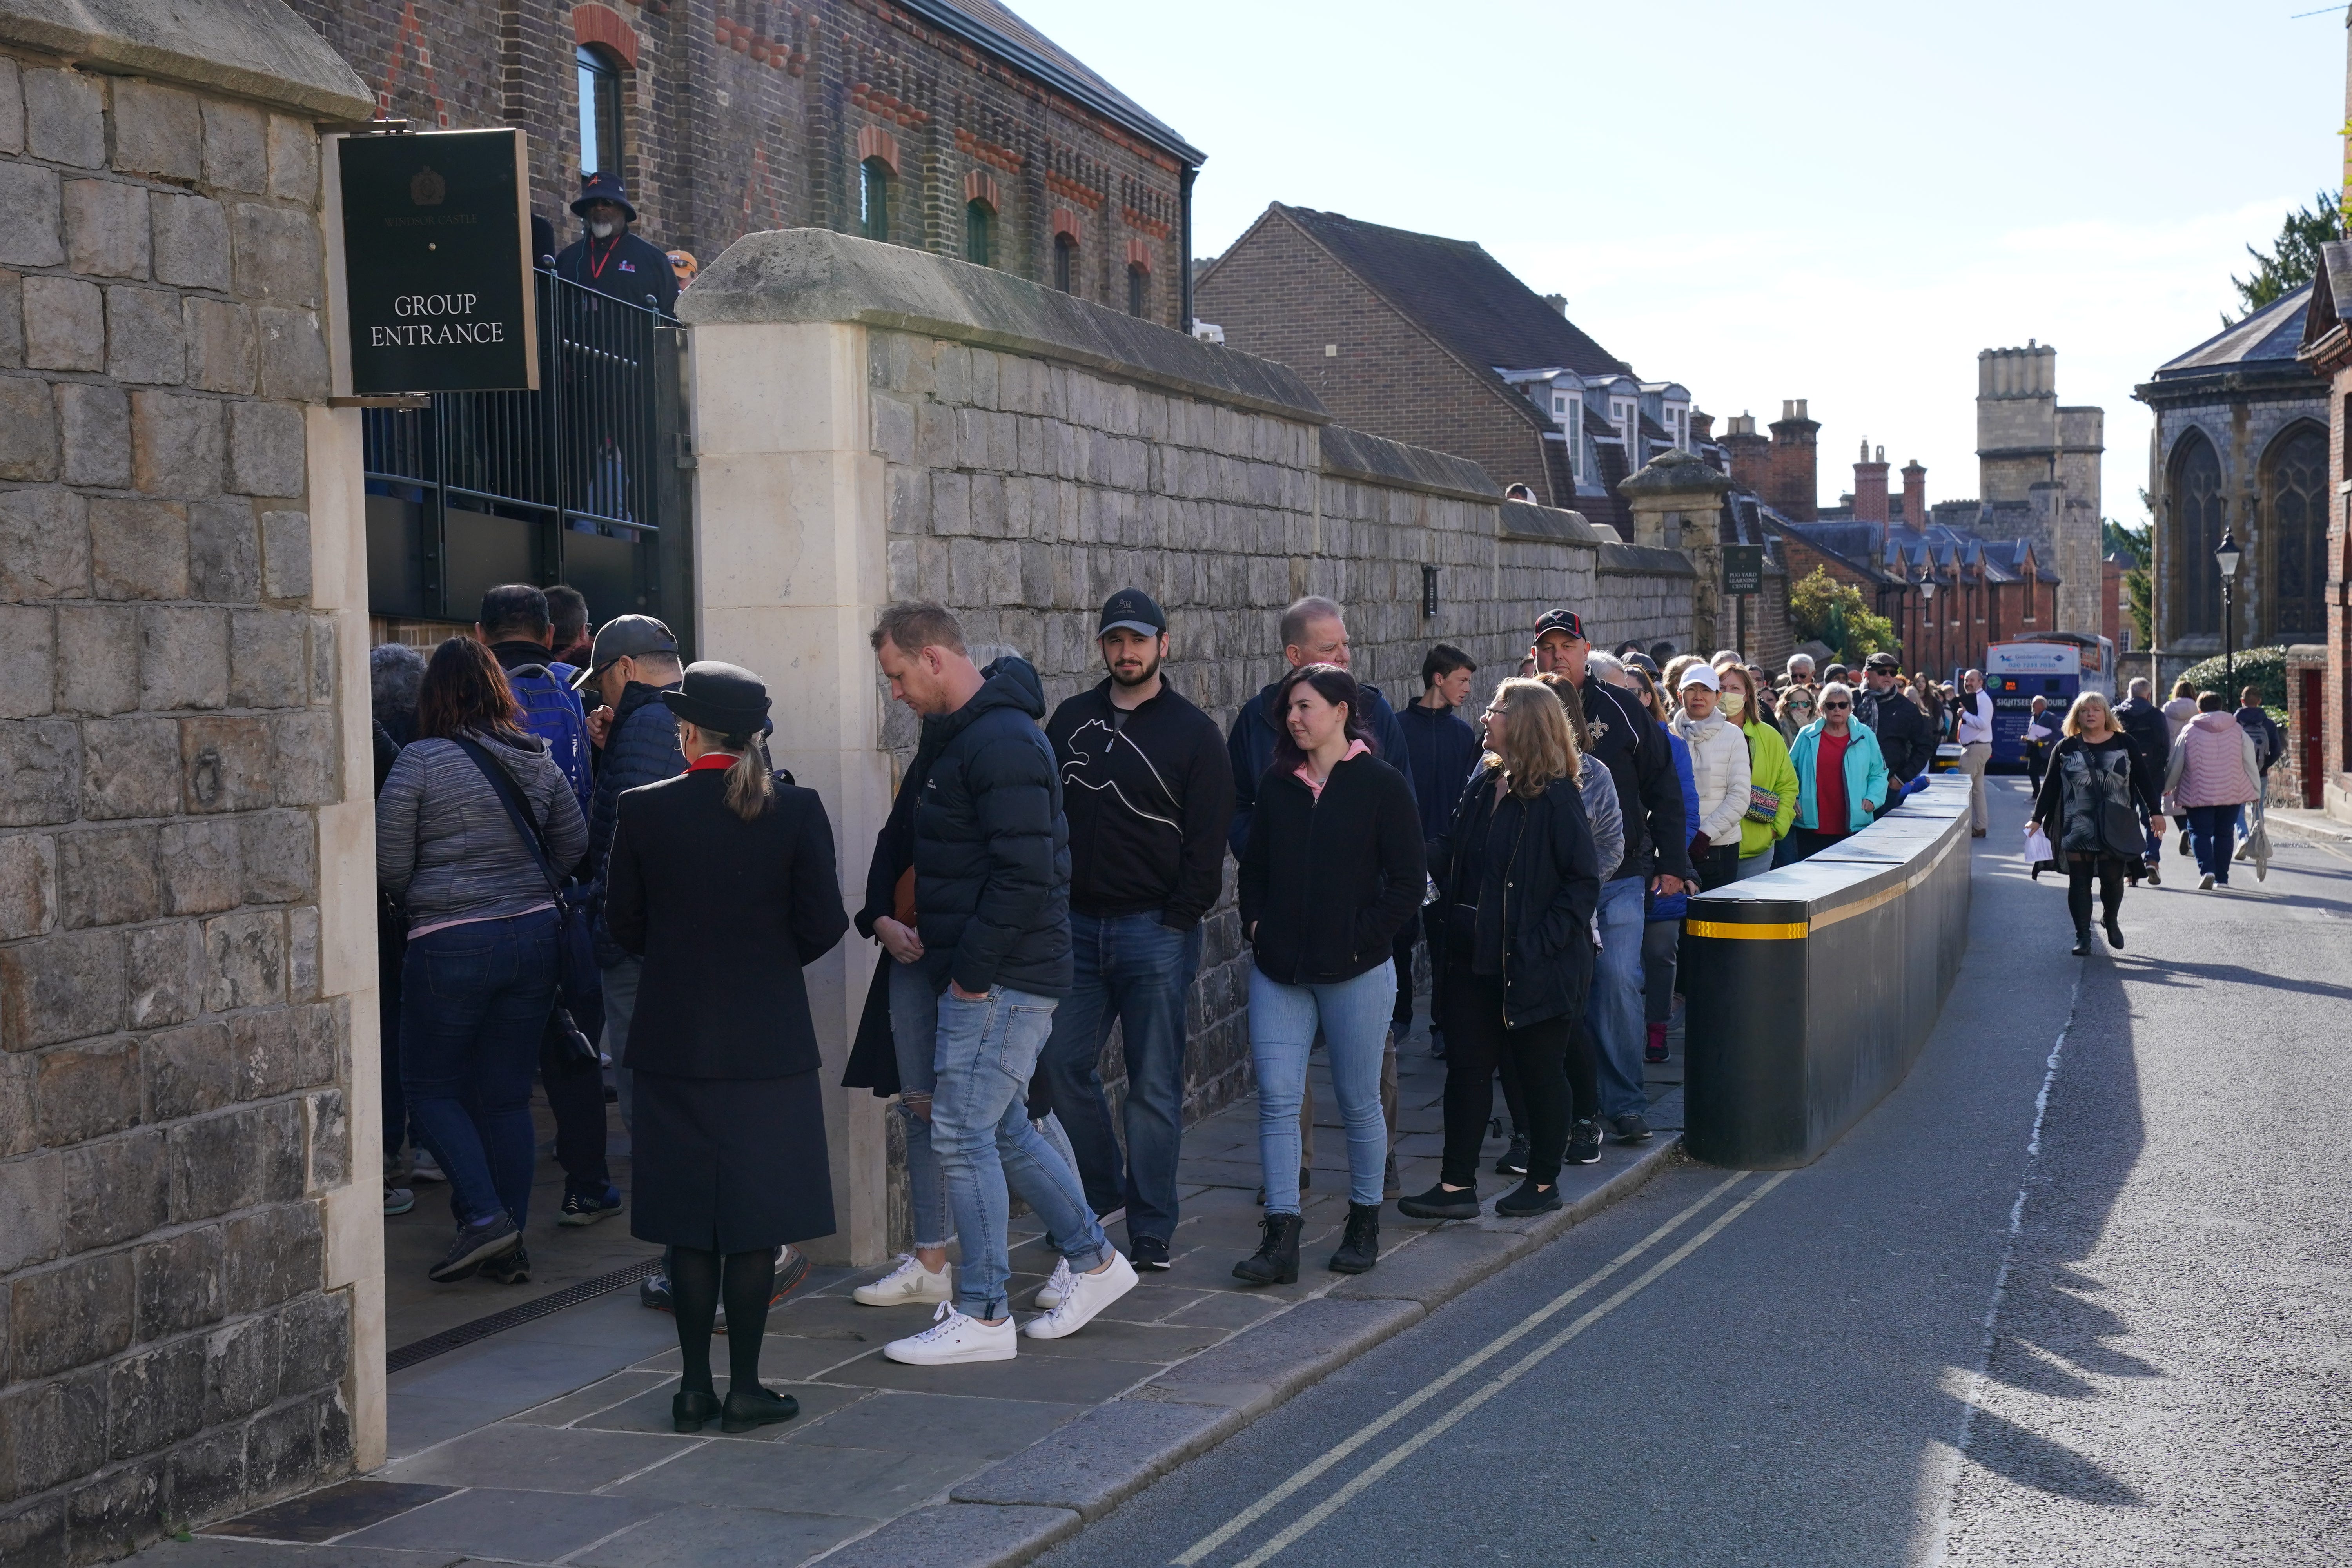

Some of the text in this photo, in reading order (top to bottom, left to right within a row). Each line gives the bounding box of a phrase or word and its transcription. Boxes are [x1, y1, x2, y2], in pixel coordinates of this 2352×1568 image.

[384, 214, 478, 227] WINDSOR CASTLE
[394, 293, 477, 317] GROUP
[370, 322, 505, 347] ENTRANCE
